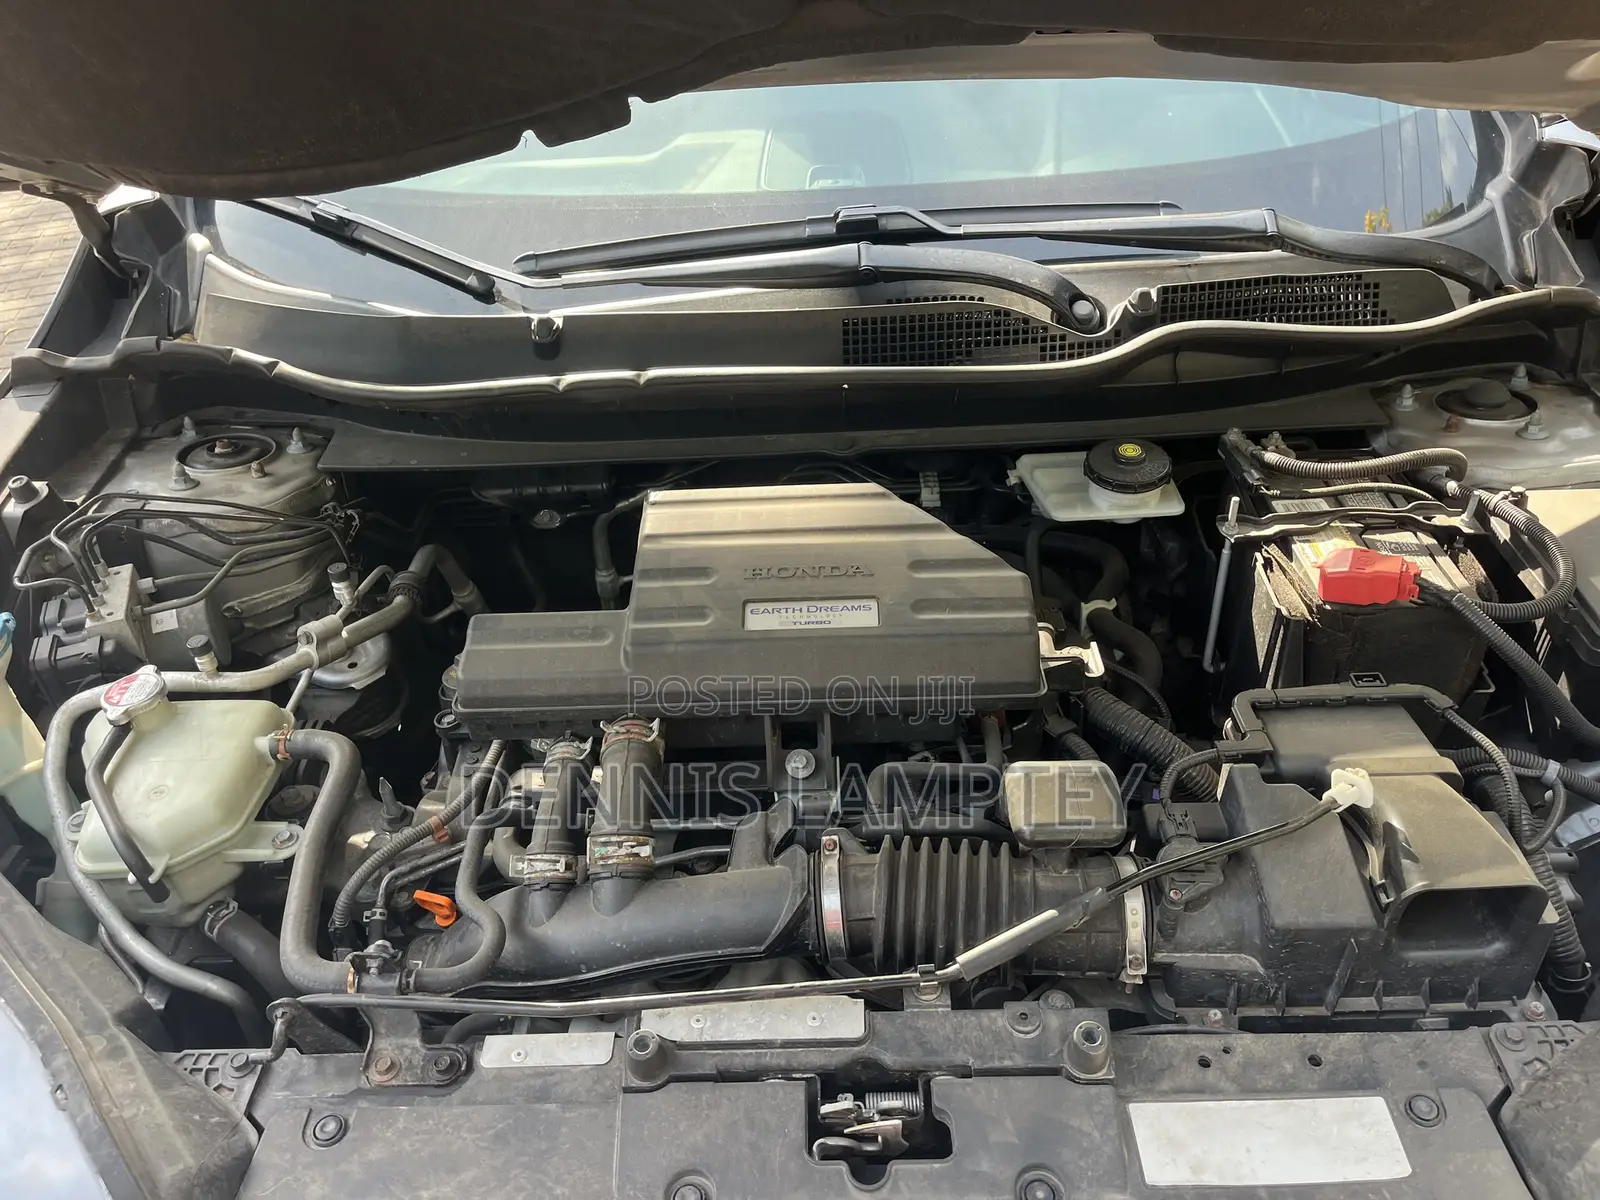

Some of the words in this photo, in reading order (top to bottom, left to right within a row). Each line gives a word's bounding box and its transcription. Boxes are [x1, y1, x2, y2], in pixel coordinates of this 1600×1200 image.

[743, 563, 876, 580] HONDA
[749, 606, 803, 615] EARTH
[806, 604, 873, 613] DREAMS
